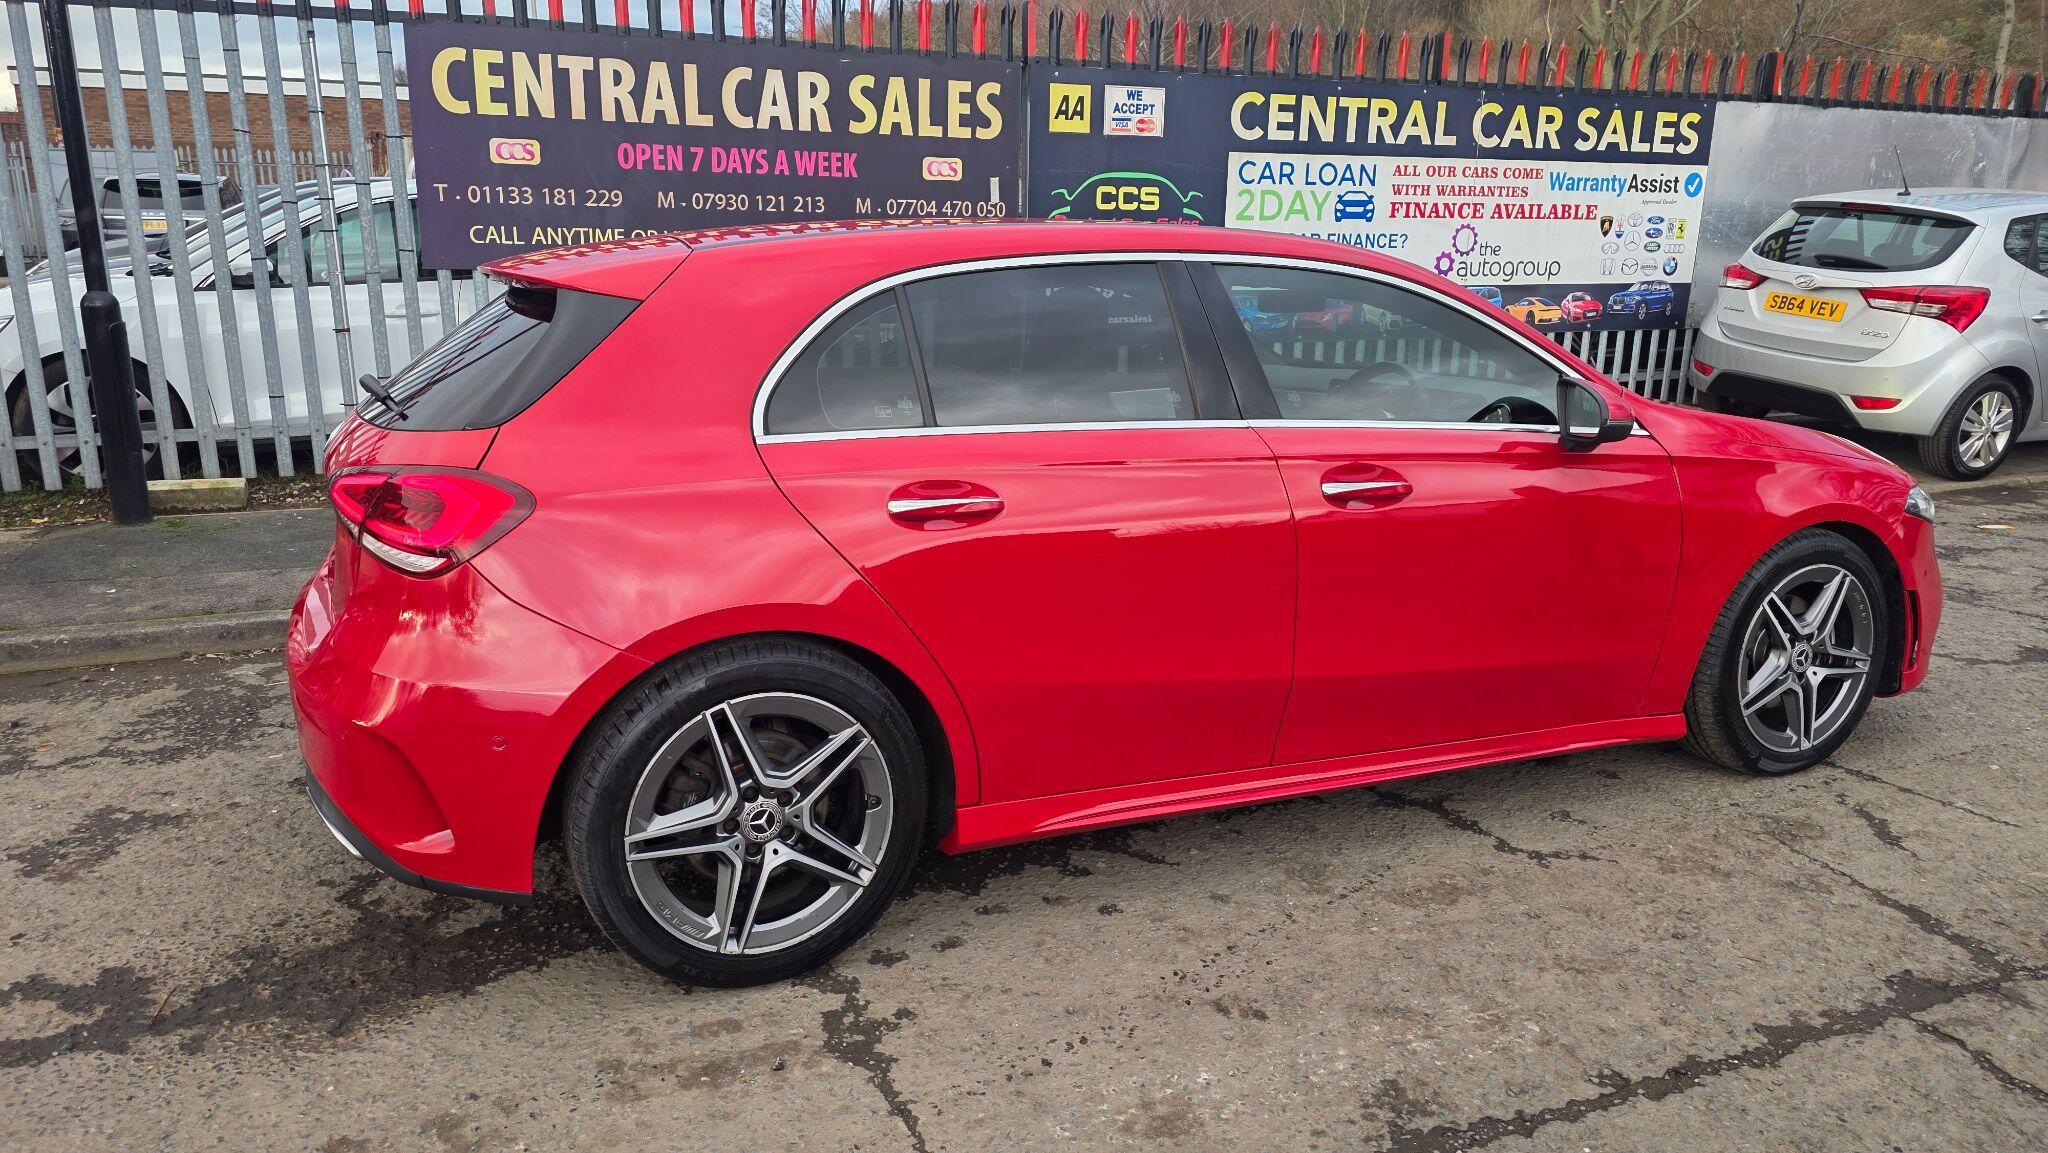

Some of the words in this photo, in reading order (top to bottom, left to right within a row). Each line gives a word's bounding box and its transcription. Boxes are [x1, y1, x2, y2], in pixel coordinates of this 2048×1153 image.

[431, 47, 714, 126] CENTRAL
[721, 66, 831, 133] CAR
[848, 74, 1002, 140] SALES
[1127, 89, 1143, 101] WE
[1054, 95, 1085, 120] AA
[1113, 102, 1155, 115] ACCEPT
[1230, 91, 1457, 146] CENTRAL
[1472, 102, 1563, 149] CAR
[1573, 107, 1702, 155] SALES
[495, 141, 535, 161] CCS
[617, 142, 683, 172] OPEN
[690, 146, 704, 172] 7
[711, 147, 769, 175] DAYS
[774, 149, 790, 176] A
[794, 150, 859, 178] WEEK
[926, 160, 959, 178] CCS
[1238, 159, 1295, 185] CAR
[1304, 161, 1377, 187] LOAN
[1392, 165, 1421, 177] ALL
[1426, 165, 1457, 178] OUR
[1462, 166, 1499, 179] CARS
[1502, 168, 1544, 180] COME
[467, 185, 533, 205] 01133
[542, 187, 576, 205] 181
[585, 189, 623, 207] 229
[1095, 185, 1160, 211] CCS
[1391, 184, 1432, 196] WITH
[1436, 185, 1529, 198] WARRANTIES
[691, 192, 749, 211] 07930
[756, 195, 785, 212] 121
[793, 196, 825, 213] 213
[887, 198, 937, 216] 07704
[942, 200, 972, 217] 470
[977, 201, 1006, 218] 050
[1235, 188, 1332, 222] 2DAY
[1388, 201, 1485, 219] FINANCE
[1490, 203, 1599, 221] AVAILABLE
[470, 225, 525, 245] CALL
[532, 227, 625, 246] ANYTIME
[1479, 241, 1502, 256] the
[1456, 258, 1561, 282] autogroup
[1770, 294, 1805, 312] SB64
[1810, 300, 1840, 318] VEV
